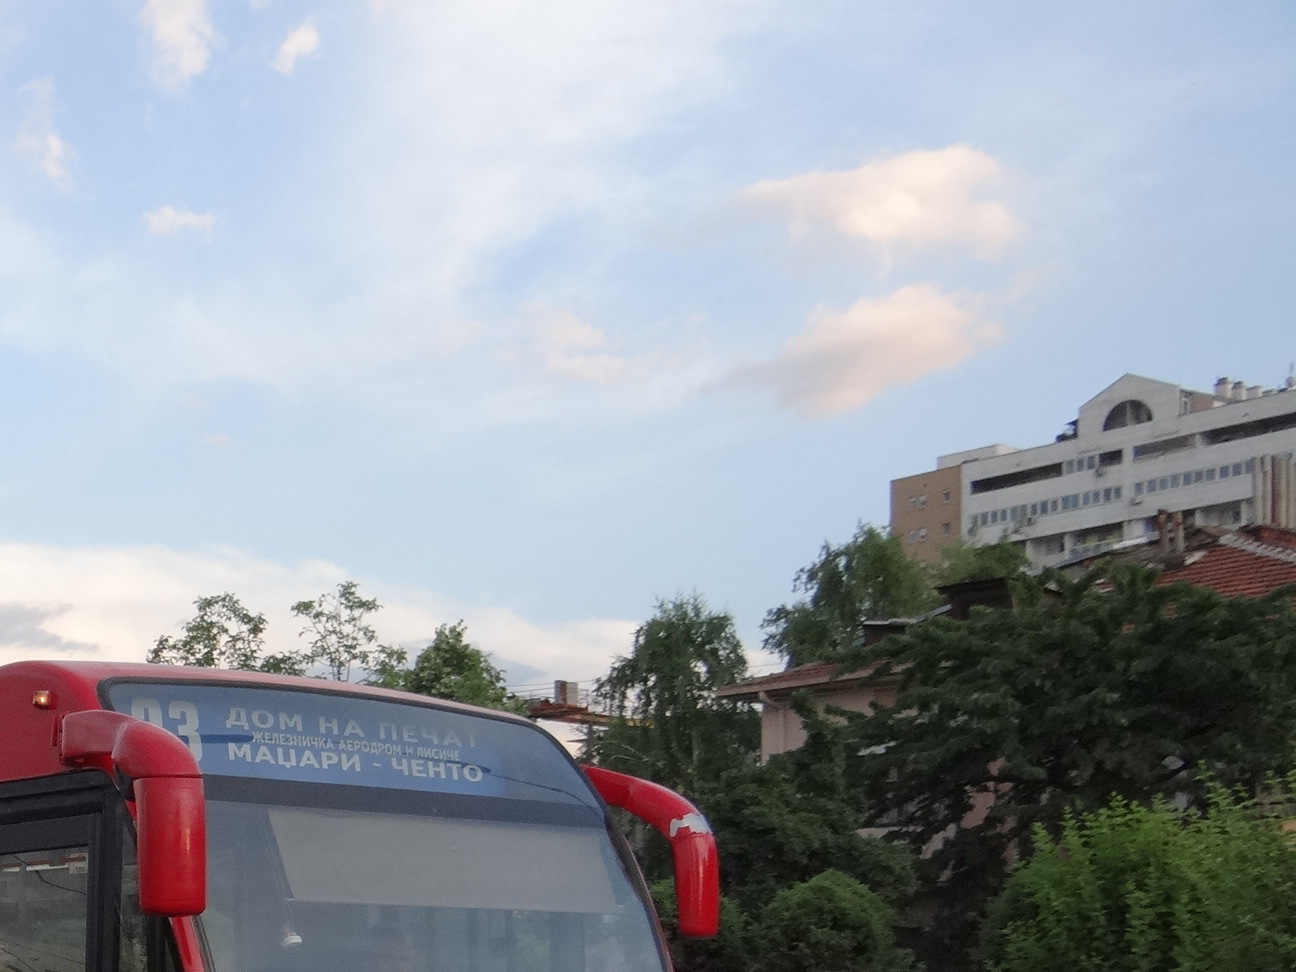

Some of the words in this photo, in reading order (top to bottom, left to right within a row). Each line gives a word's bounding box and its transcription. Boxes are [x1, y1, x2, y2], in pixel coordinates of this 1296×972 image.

[225, 706, 303, 732] ДОМ
[318, 716, 366, 738] НА
[379, 721, 477, 748] ПЕЧАТ
[227, 742, 362, 773] МАЏАРИ
[390, 757, 484, 783] ЧЕНТО
